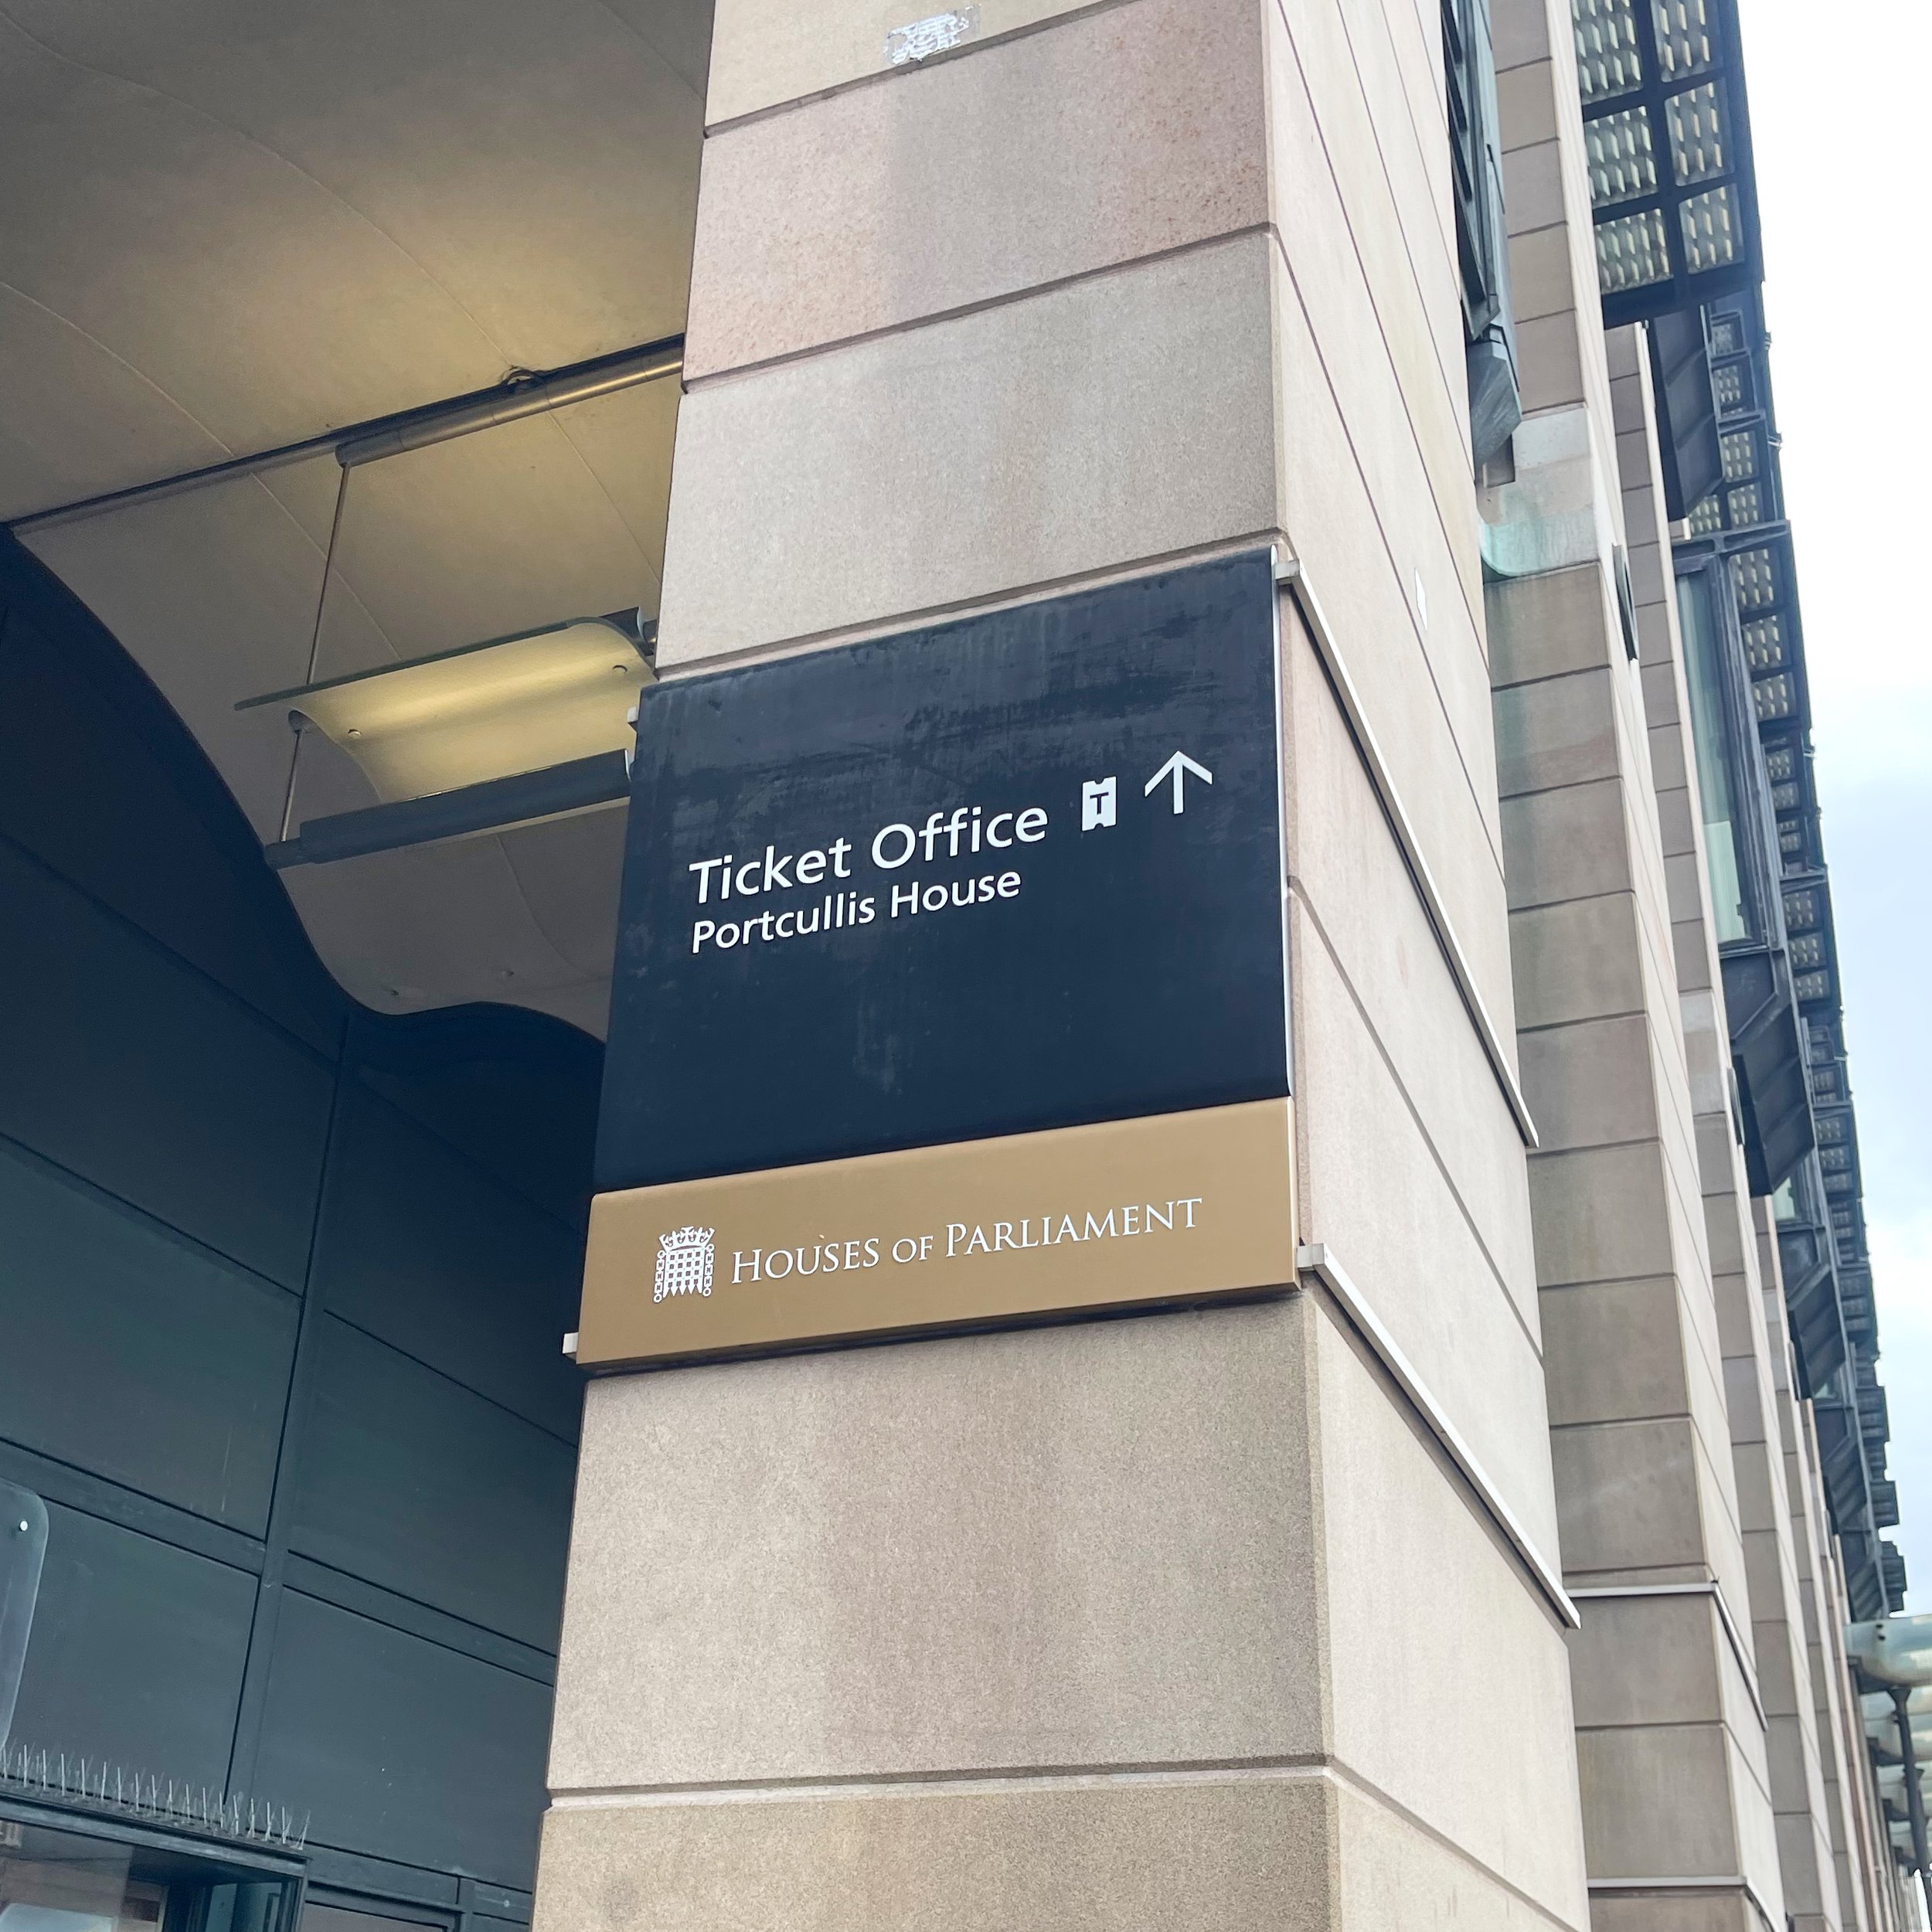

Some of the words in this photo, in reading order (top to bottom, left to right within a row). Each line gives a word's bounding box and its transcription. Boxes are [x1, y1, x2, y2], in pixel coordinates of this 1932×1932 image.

[1090, 791, 1110, 815] T
[689, 837, 852, 903] Ticket
[872, 807, 1048, 869] Office
[692, 892, 876, 954] Portcullis
[891, 871, 1021, 918] House
[731, 1237, 879, 1284] HOUSES
[892, 1235, 934, 1264] OF
[945, 1197, 1202, 1257] PARLIAMENT
